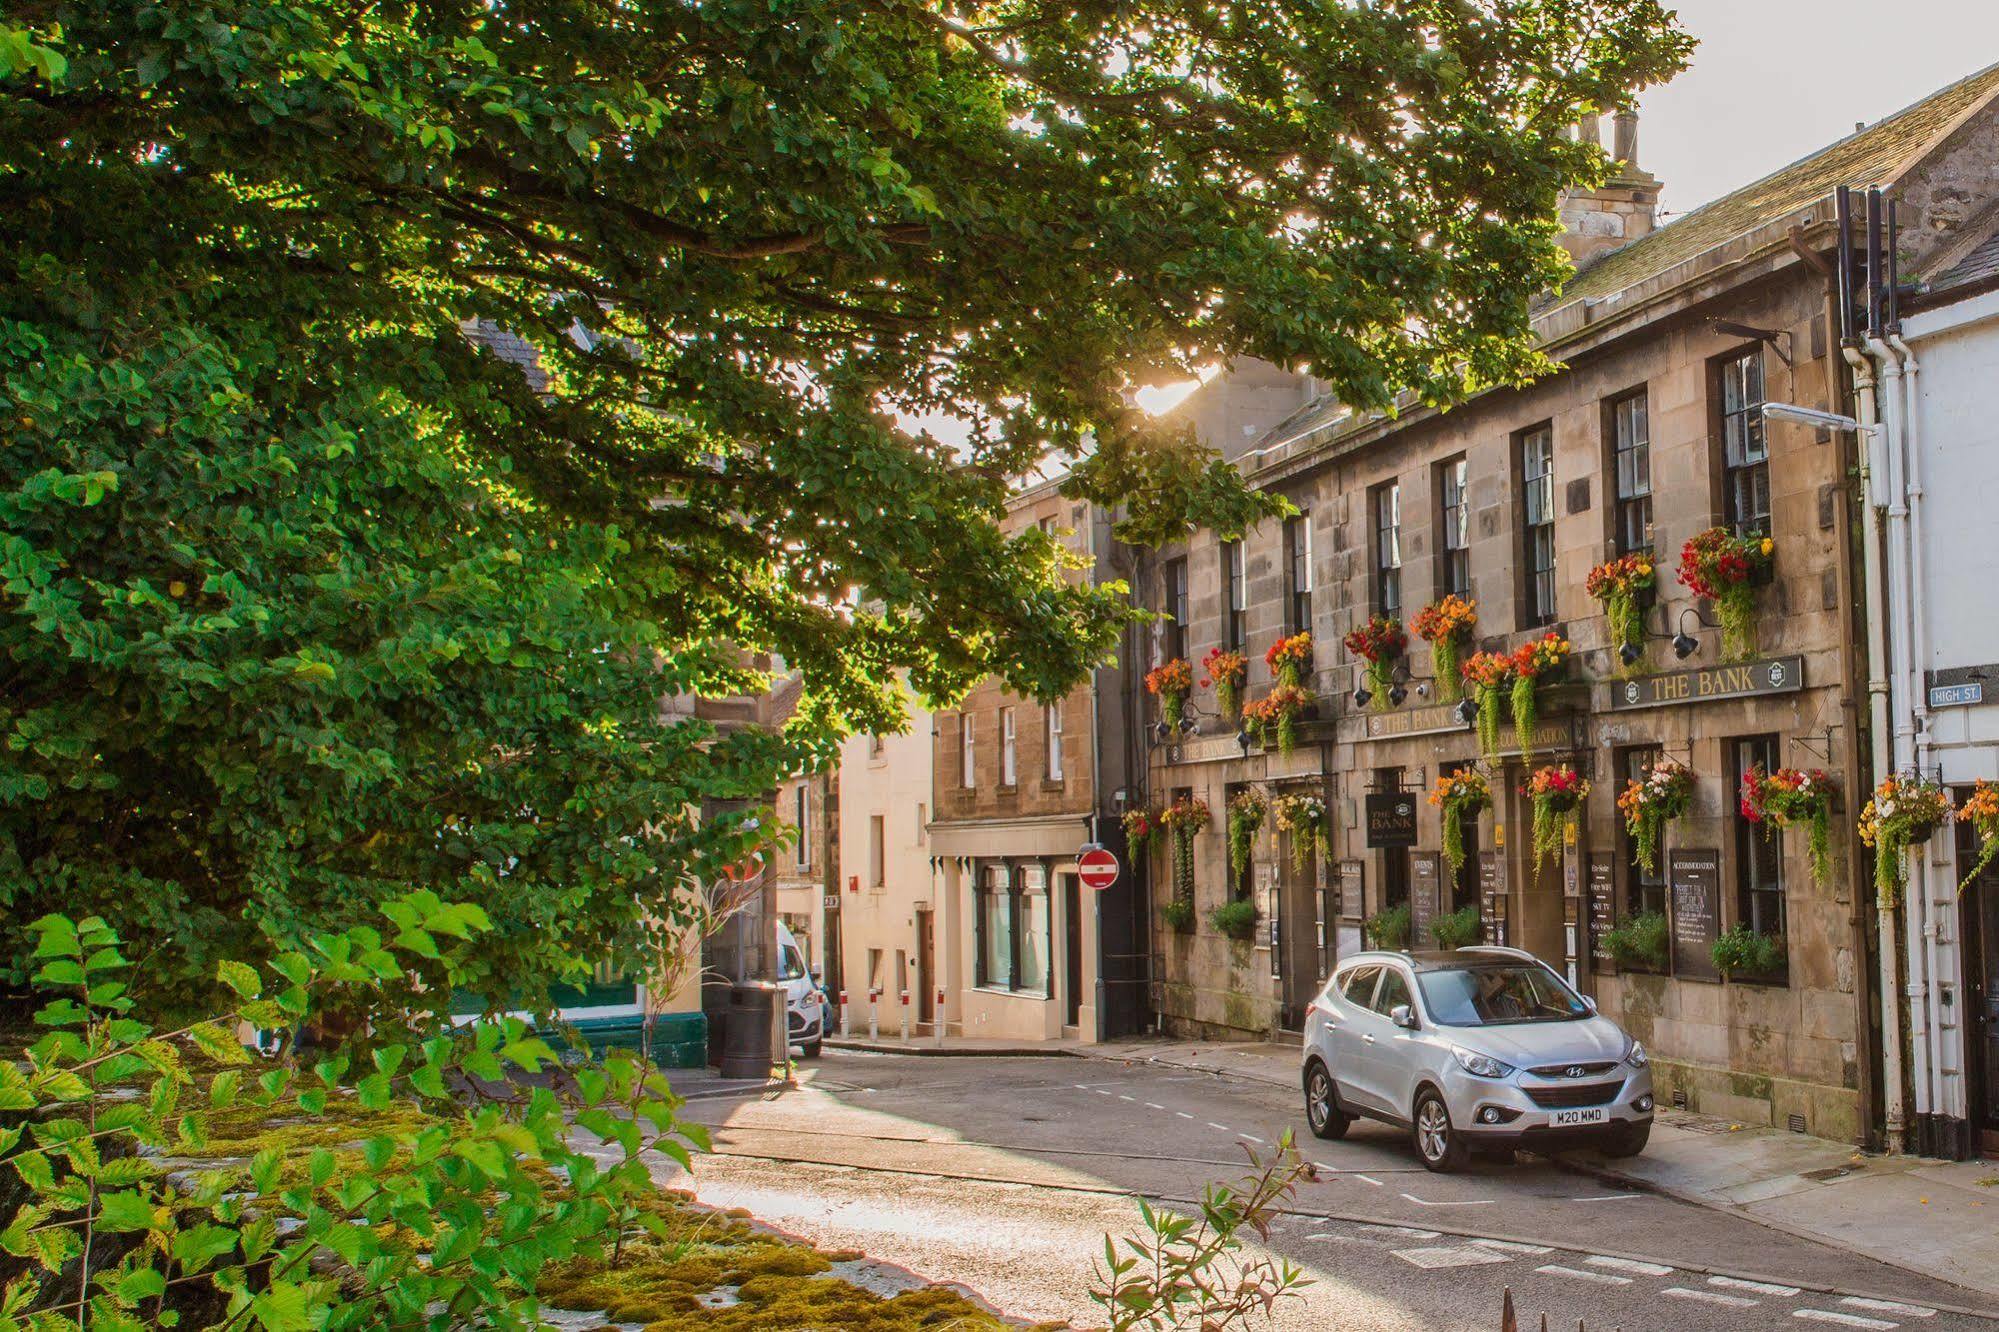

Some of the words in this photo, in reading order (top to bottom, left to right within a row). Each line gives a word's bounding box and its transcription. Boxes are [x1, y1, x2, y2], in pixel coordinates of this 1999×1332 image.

[1651, 675, 1690, 700] THE
[1700, 665, 1755, 695] BANK
[1935, 689, 1960, 702] HIGH
[1964, 687, 1979, 700] ST.
[1384, 713, 1409, 733] THE
[1413, 709, 1449, 730] BANK
[1183, 744, 1200, 760] THE
[1371, 818, 1412, 829] BANK
[1673, 861, 1715, 870] ACCOMMODATION
[1557, 1111, 1579, 1124] M20
[1581, 1109, 1602, 1121] MMD
